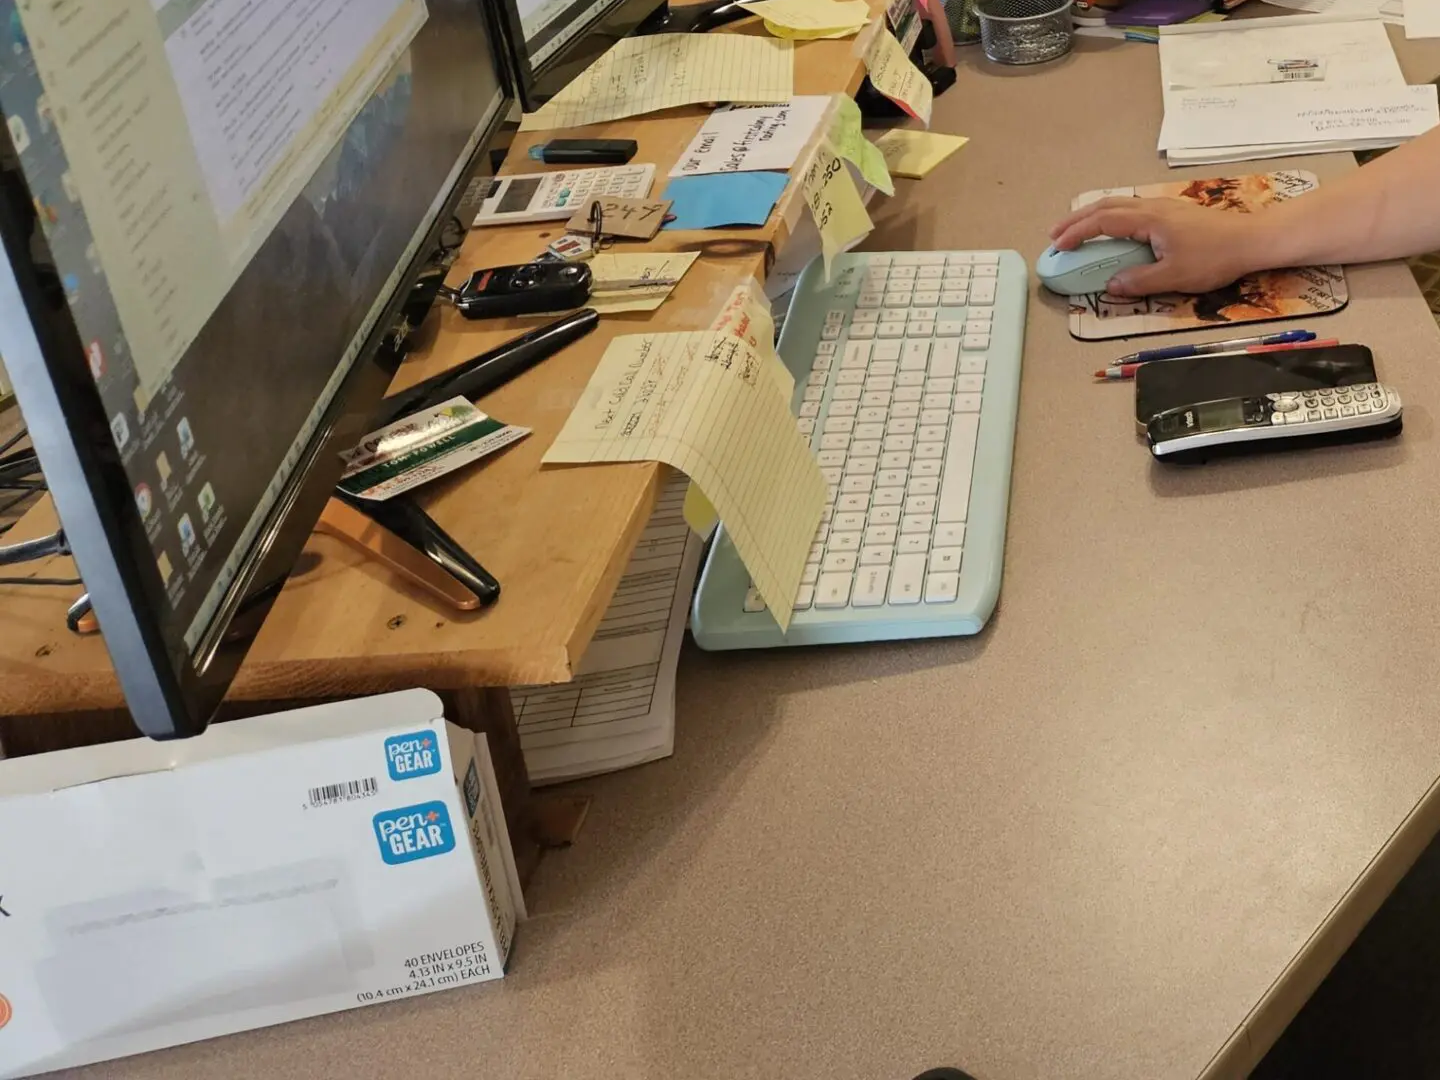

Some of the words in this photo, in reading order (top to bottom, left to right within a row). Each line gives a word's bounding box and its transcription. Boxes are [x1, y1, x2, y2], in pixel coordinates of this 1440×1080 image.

[395, 750, 434, 773] GEAR
[389, 824, 445, 856] GEAR
[404, 956, 419, 968] 40
[421, 941, 485, 966] ENVELOPES
[408, 965, 430, 979] 4.13
[433, 962, 445, 974] IN
[448, 963, 454, 971] x
[455, 956, 473, 969] 9.5
[475, 953, 488, 964] IN
[356, 989, 384, 1002] (10.4
[386, 985, 404, 997] cm
[405, 983, 412, 992] x
[414, 978, 435, 991] 24.1
[437, 972, 459, 985] cm)
[461, 965, 491, 980] EACH
